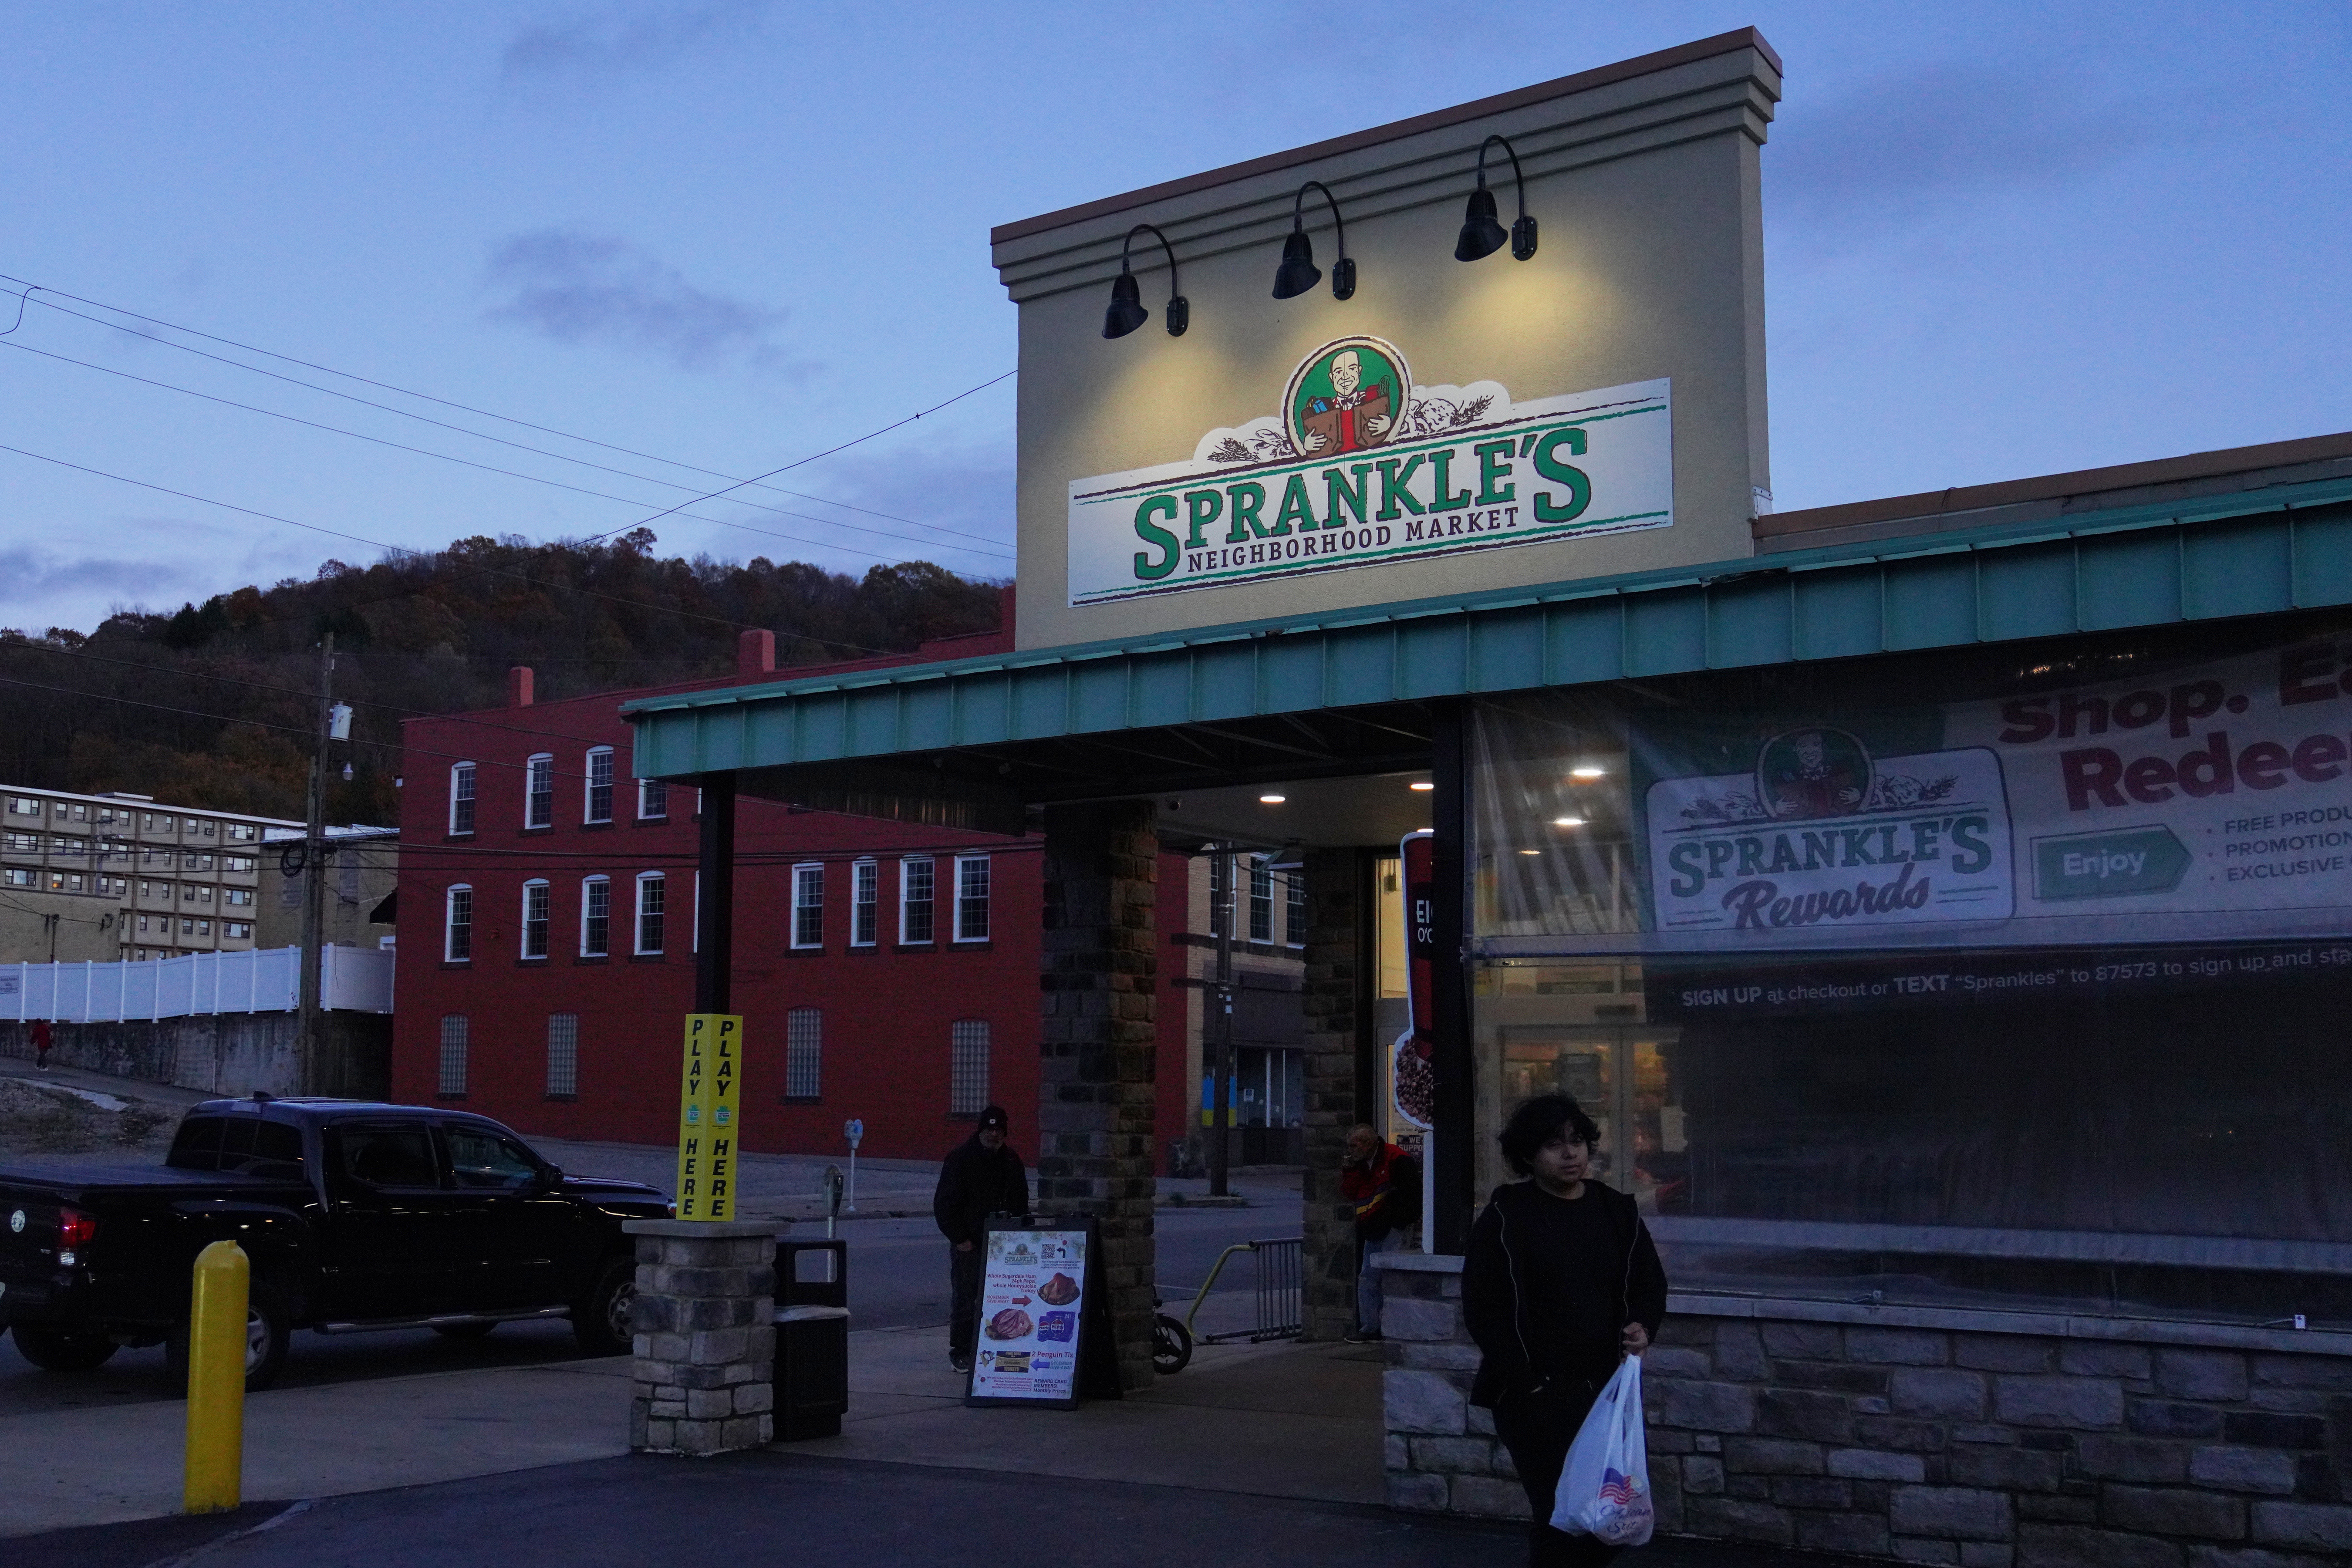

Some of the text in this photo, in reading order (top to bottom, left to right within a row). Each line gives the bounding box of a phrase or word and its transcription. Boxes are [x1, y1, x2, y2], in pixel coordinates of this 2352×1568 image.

[1134, 428, 1591, 580] SPRANKLE'S
[1188, 507, 1519, 573] NEIGHBORHOOD MARKET
[2061, 731, 2352, 811] Redee
[1668, 816, 1992, 898] SPRANKLE'S
[2225, 815, 2274, 834] FREE
[1721, 863, 1930, 931] Rewards
[2063, 847, 2146, 879] Enjoy
[2227, 856, 2344, 881] EXCLUSIVE
[1416, 900, 1433, 923] EI
[1682, 988, 1728, 1006] SIGN
[1733, 987, 1762, 1004] UP
[1767, 988, 1785, 1001] at
[1788, 983, 1866, 1000] checkout
[1871, 983, 1889, 995] or
[1893, 974, 1950, 993] TEXT
[2070, 969, 2089, 983] to
[2095, 962, 2156, 981] 87573
[2163, 962, 2183, 975] to
[2189, 958, 2232, 976] sign
[2239, 956, 2264, 972] up
[2272, 949, 2312, 967] and
[689, 1019, 703, 1096] PLAY
[717, 1020, 734, 1096] PLAY
[683, 1138, 698, 1215] HERE
[711, 1139, 729, 1216] HERE
